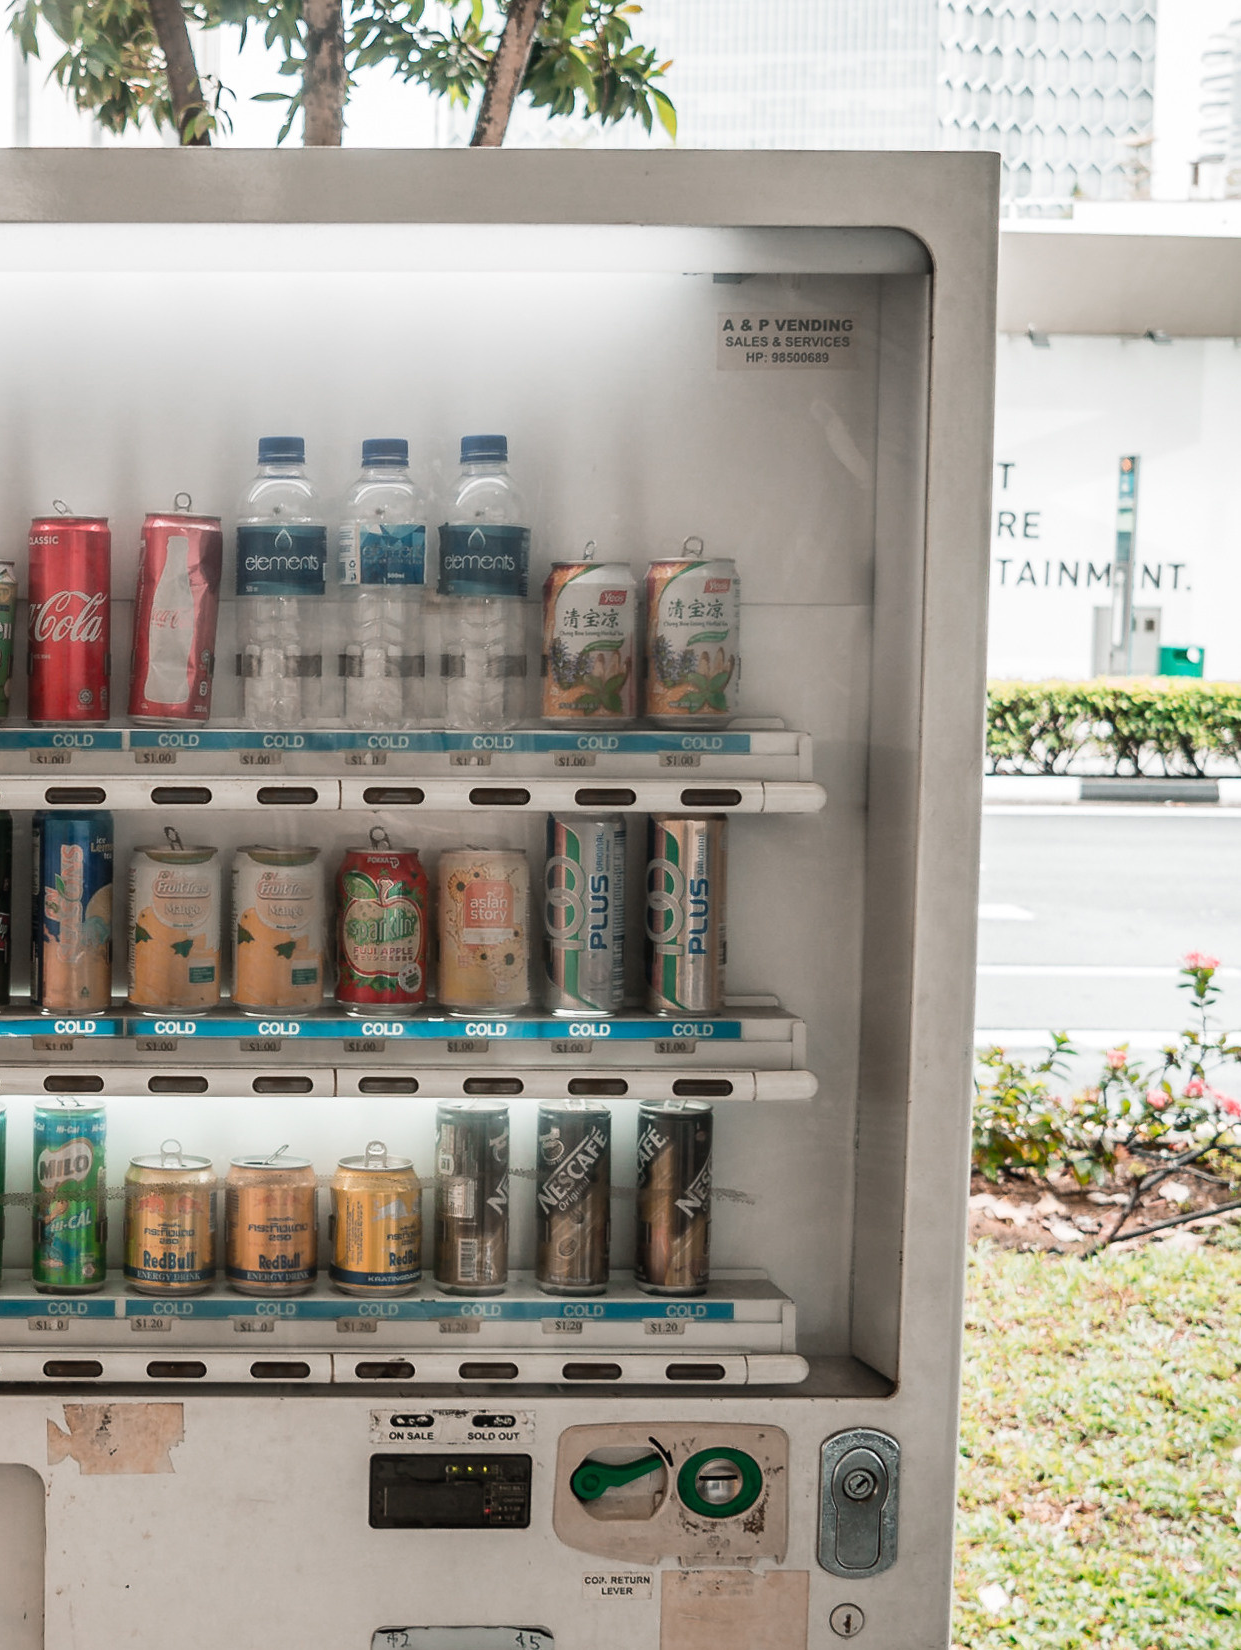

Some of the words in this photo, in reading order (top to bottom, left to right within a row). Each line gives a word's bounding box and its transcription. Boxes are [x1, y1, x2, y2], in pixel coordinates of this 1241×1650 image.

[723, 319, 734, 331] A
[740, 319, 752, 331] &
[759, 320, 769, 331] P
[775, 319, 853, 331] VENDING
[726, 337, 768, 347] SALES
[772, 337, 781, 347] &
[785, 337, 850, 347] SERVICES
[746, 352, 768, 363] HP:
[772, 352, 829, 363] 98500689
[997, 462, 1015, 489] T
[997, 511, 1041, 538] RE
[245, 553, 319, 571] elements
[444, 553, 515, 571] elements
[997, 559, 1192, 590] TAINMNT.
[668, 599, 724, 619] 清宝凉
[563, 608, 619, 628] 清宝凉
[53, 734, 93, 747] COLD
[158, 734, 199, 747] COLD
[263, 735, 304, 748] COLD
[368, 736, 409, 749] COLD
[473, 736, 512, 749] COLD
[578, 737, 618, 749] COLD
[682, 737, 722, 750] COLD
[37, 754, 64, 764] $1.00
[144, 752, 171, 764] $1.00
[243, 755, 269, 766] $1.00
[559, 756, 586, 768] $1.00
[666, 755, 693, 766] $1.00
[596, 832, 604, 872] ORIGINAL
[157, 883, 186, 893] Fruit
[260, 884, 288, 895] Fruit
[470, 892, 508, 909] asian
[165, 903, 202, 916] Mango
[268, 904, 304, 917] Mango
[470, 909, 507, 922] story
[589, 874, 609, 950] PLUS
[688, 878, 709, 955] PLUS
[349, 908, 415, 942] sparklin'
[353, 946, 378, 955] FUJI
[380, 946, 413, 955] APPLE
[54, 1021, 96, 1034] COLD
[155, 1021, 196, 1035] COLD
[259, 1023, 299, 1035] COLD
[362, 1023, 403, 1036] COLD
[466, 1023, 506, 1036] COLD
[569, 1023, 610, 1037] COLD
[672, 1024, 713, 1036] COLD
[146, 1041, 172, 1052] $1.00
[249, 1041, 277, 1052] $1.00
[349, 1042, 375, 1053] $1.00
[448, 1042, 474, 1053] $1.00
[556, 1043, 583, 1054] $1.00
[660, 1042, 686, 1053] $1.00
[56, 1125, 79, 1134] Hi-Cal
[40, 1155, 89, 1180] MILO
[537, 1125, 608, 1215] NESCAFÉ
[558, 1175, 591, 1212] Original
[50, 1208, 92, 1231] HI-CAL
[143, 1250, 195, 1269] RedBull
[258, 1252, 301, 1269] RedBull
[137, 1270, 172, 1281] ENERGY
[173, 1271, 200, 1281] DRINK
[246, 1271, 285, 1281] ENERGY
[286, 1271, 309, 1280] DRINK
[48, 1302, 87, 1314] COLD
[153, 1302, 193, 1315] COLD
[256, 1303, 296, 1315] COLD
[358, 1303, 398, 1316] COLD
[461, 1304, 501, 1316] COLD
[563, 1305, 603, 1317] COLD
[666, 1305, 706, 1317] COLD
[136, 1318, 163, 1329] $1.20
[344, 1322, 370, 1332] $1.20
[440, 1322, 467, 1333] $1.20
[555, 1320, 582, 1331] $1.20
[651, 1322, 677, 1333] $1.20
[389, 1432, 405, 1440] ON
[407, 1432, 434, 1440] SALE
[467, 1432, 495, 1440] SOLD
[498, 1432, 520, 1440] OUT
[610, 1576, 650, 1584] RETURN
[601, 1587, 633, 1595] LEVER
